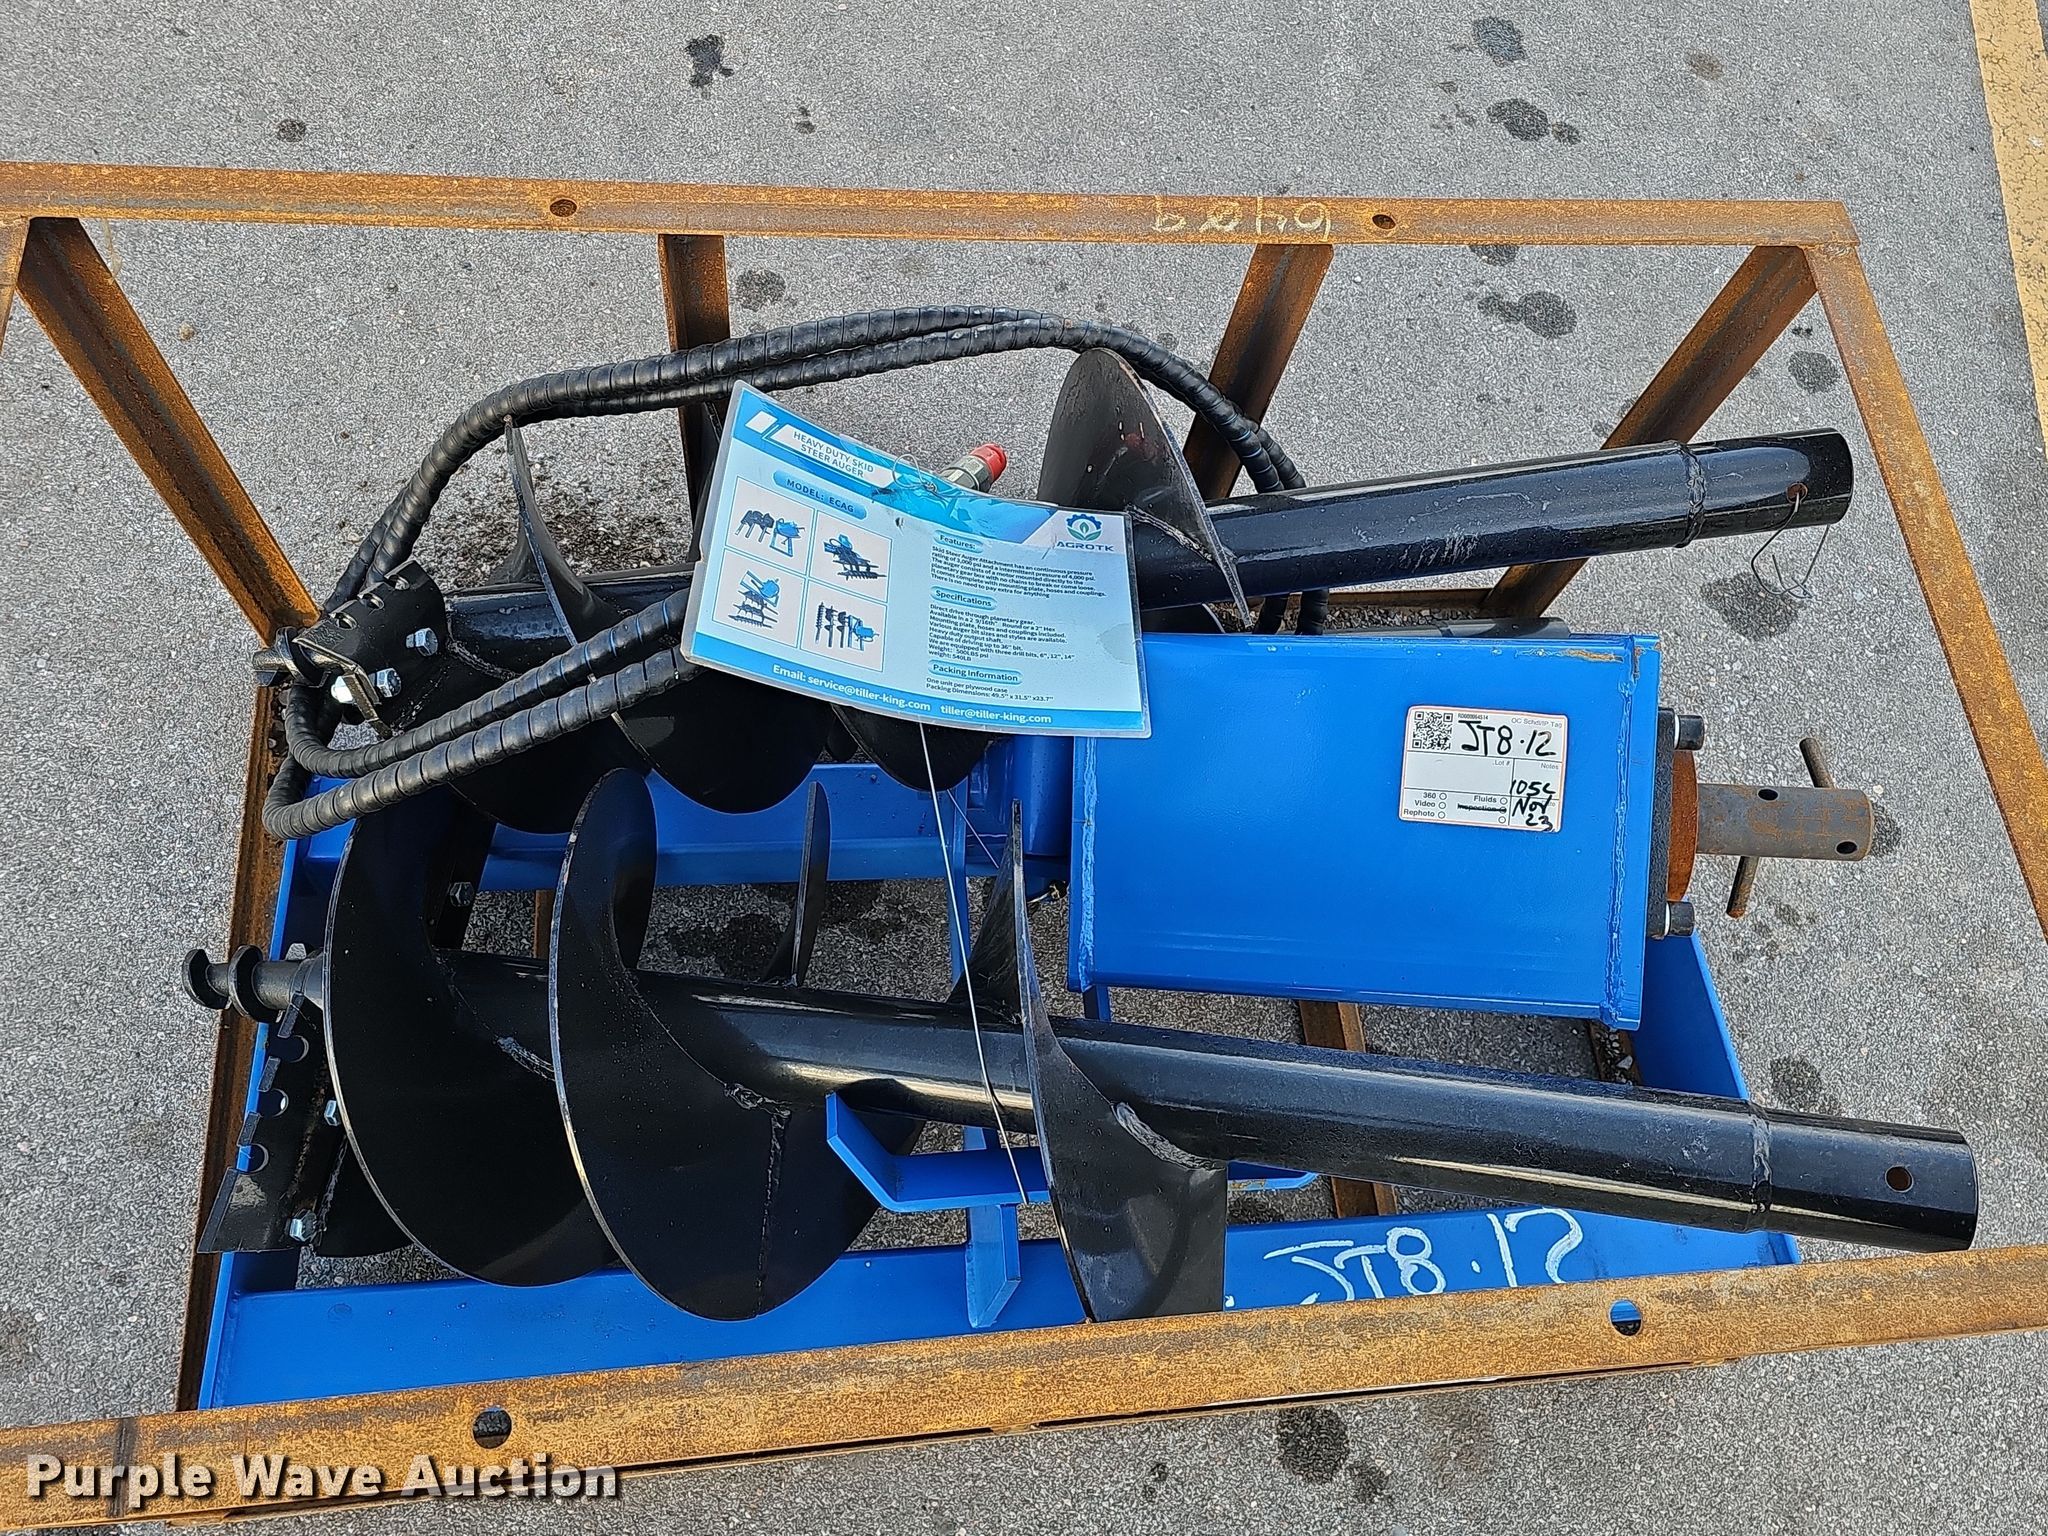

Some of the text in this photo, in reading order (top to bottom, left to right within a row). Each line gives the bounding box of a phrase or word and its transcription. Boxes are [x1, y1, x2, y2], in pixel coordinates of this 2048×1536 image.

[794, 432, 874, 473] HEAVY DUTY SKID
[801, 444, 864, 478] STEER AUGER
[787, 479, 855, 513] MODEL: ECAG
[940, 534, 976, 549] Features:
[1057, 541, 1114, 551] AGROTK
[936, 590, 992, 606] Specifications
[933, 664, 1018, 681] Packing Information
[773, 664, 1051, 723] Email: service@tiller-king.com tiller@tiller-king.com
[926, 683, 951, 693] Packing
[952, 688, 990, 697] Dimensions:
[965, 684, 992, 692] plywood
[1474, 795, 1497, 803] Fluids
[1403, 809, 1435, 817] Rephoto
